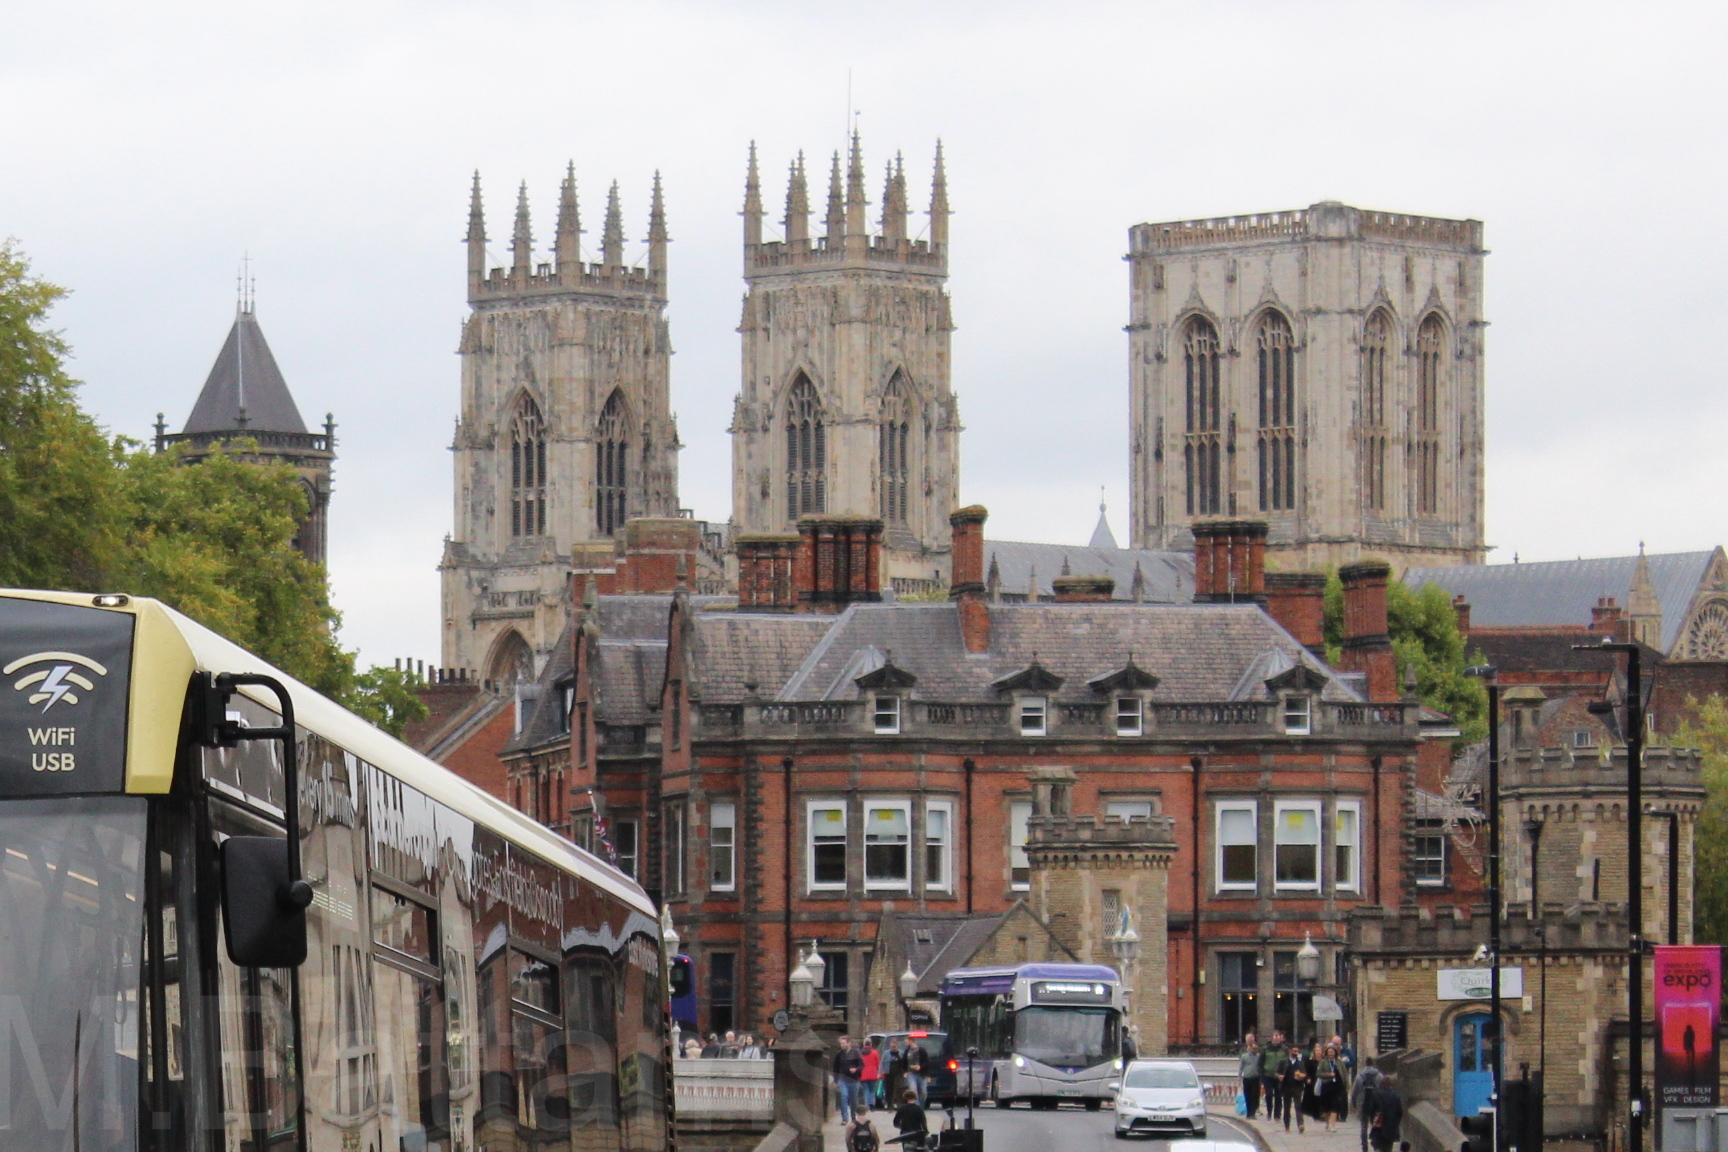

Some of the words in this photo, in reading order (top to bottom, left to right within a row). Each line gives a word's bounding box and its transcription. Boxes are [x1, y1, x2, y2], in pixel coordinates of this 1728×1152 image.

[27, 727, 76, 747] WiFi
[31, 753, 76, 772] USB
[1663, 974, 1712, 991] expo
[1663, 1086, 1689, 1095] GAMES
[1694, 1086, 1712, 1095] FILM
[1663, 1096, 1678, 1104] VFX
[1683, 1096, 1711, 1104] DESIGN
